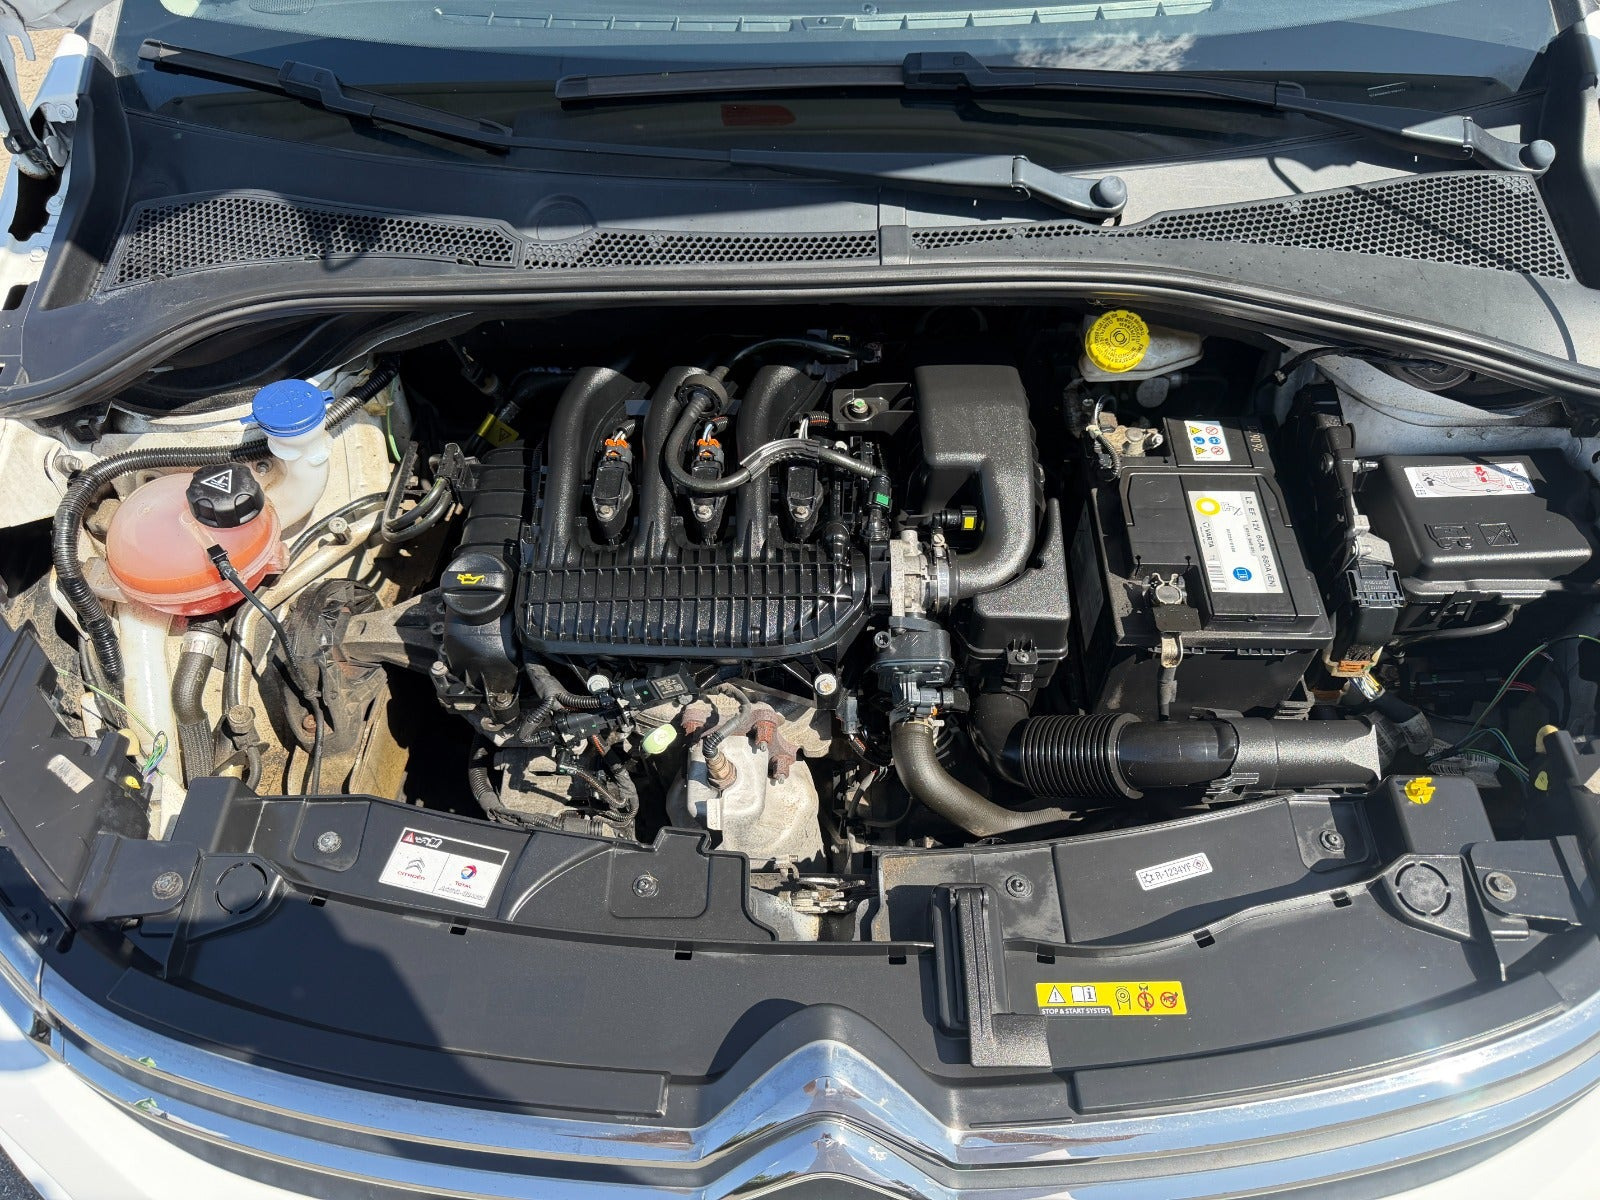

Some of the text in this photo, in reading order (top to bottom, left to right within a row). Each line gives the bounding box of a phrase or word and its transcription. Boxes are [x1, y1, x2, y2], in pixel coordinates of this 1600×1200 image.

[1244, 496, 1253, 504] L2
[1248, 507, 1256, 516] EF
[1251, 520, 1261, 531] 12V
[1206, 529, 1215, 548] VARTA
[1255, 534, 1265, 552] 60Ah
[1266, 574, 1276, 588] (EN)
[455, 880, 472, 889] TOTAL
